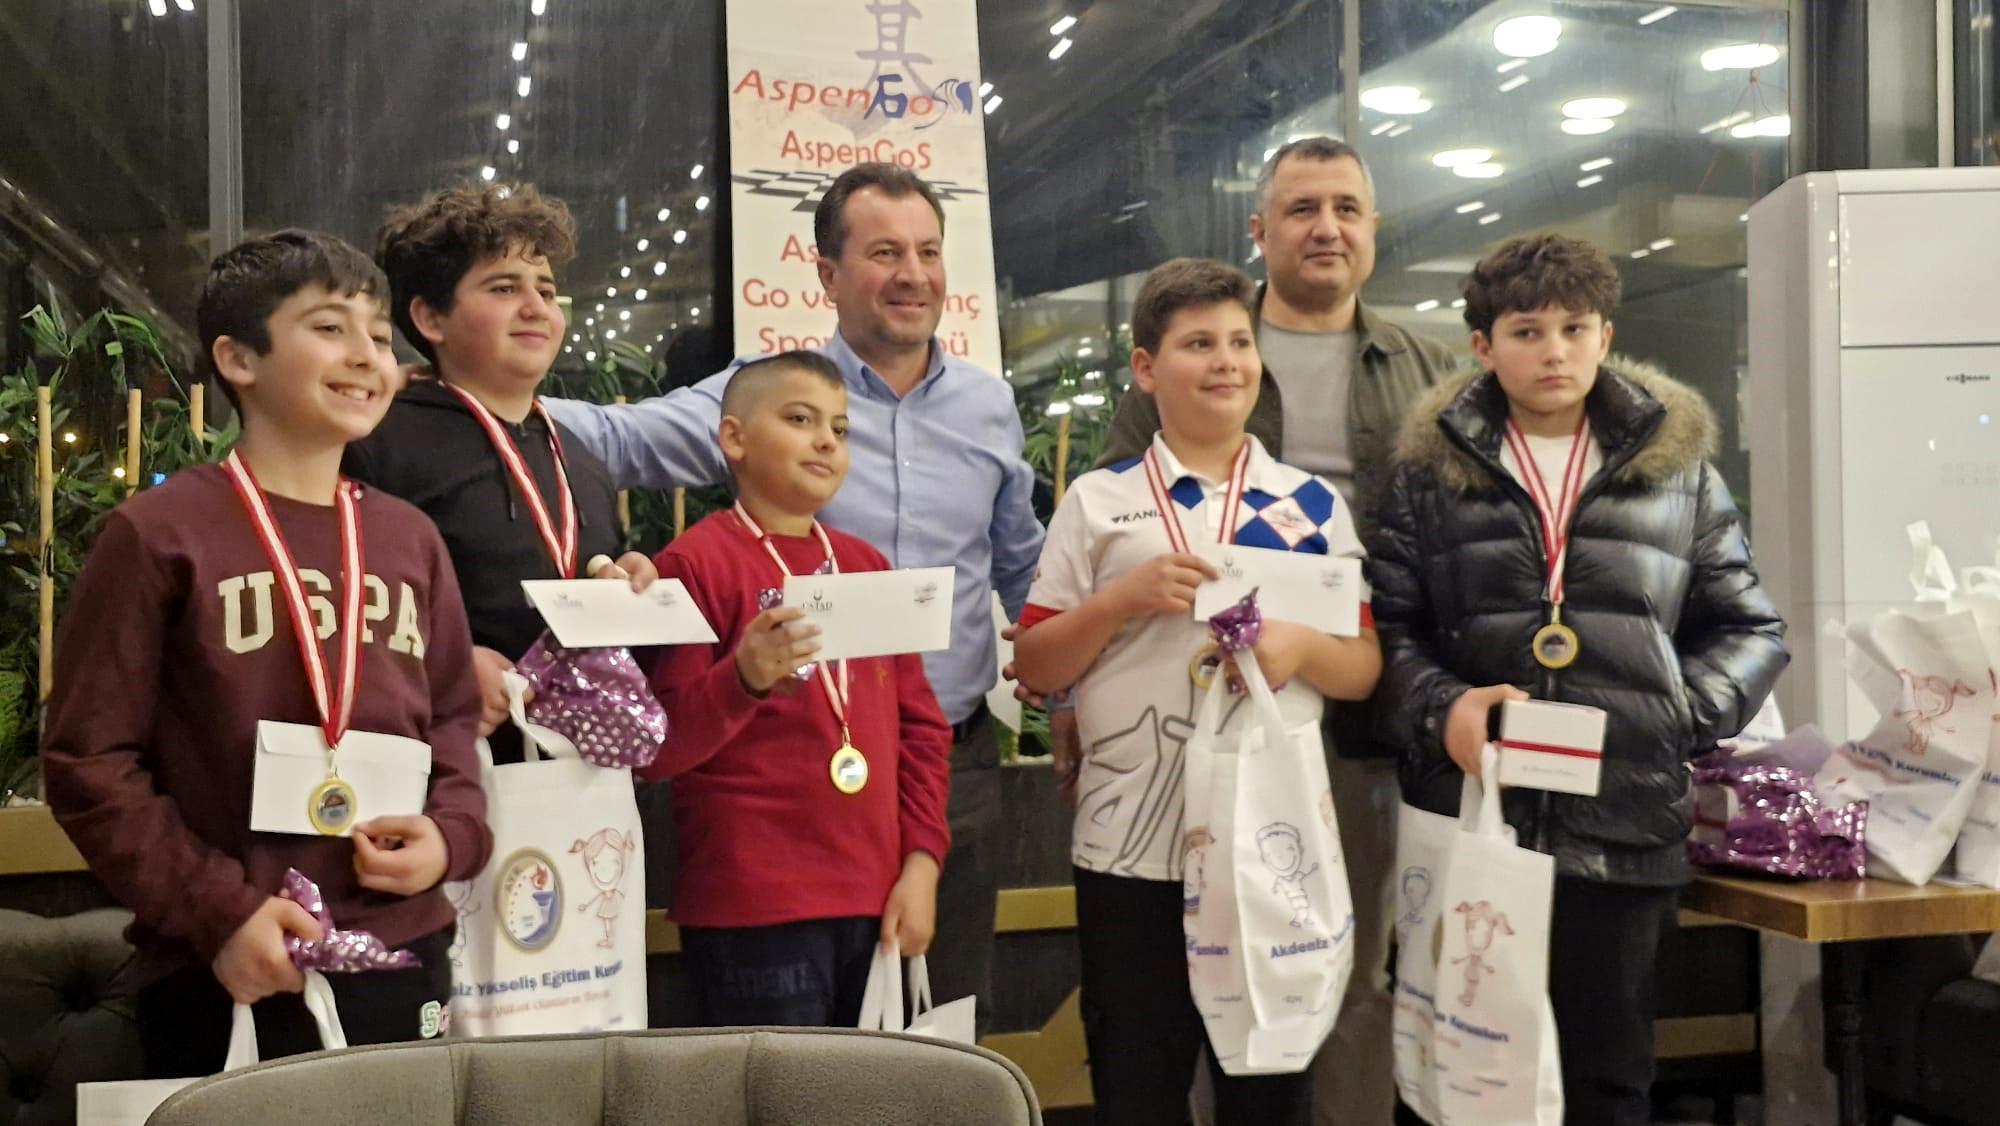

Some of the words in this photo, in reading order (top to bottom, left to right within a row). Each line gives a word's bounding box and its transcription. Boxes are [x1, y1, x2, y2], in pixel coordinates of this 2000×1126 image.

[780, 130, 932, 169] AspenGoS
[742, 279, 789, 308] Go
[218, 568, 425, 660] USPA
[1270, 937, 1330, 959] Akdeniz
